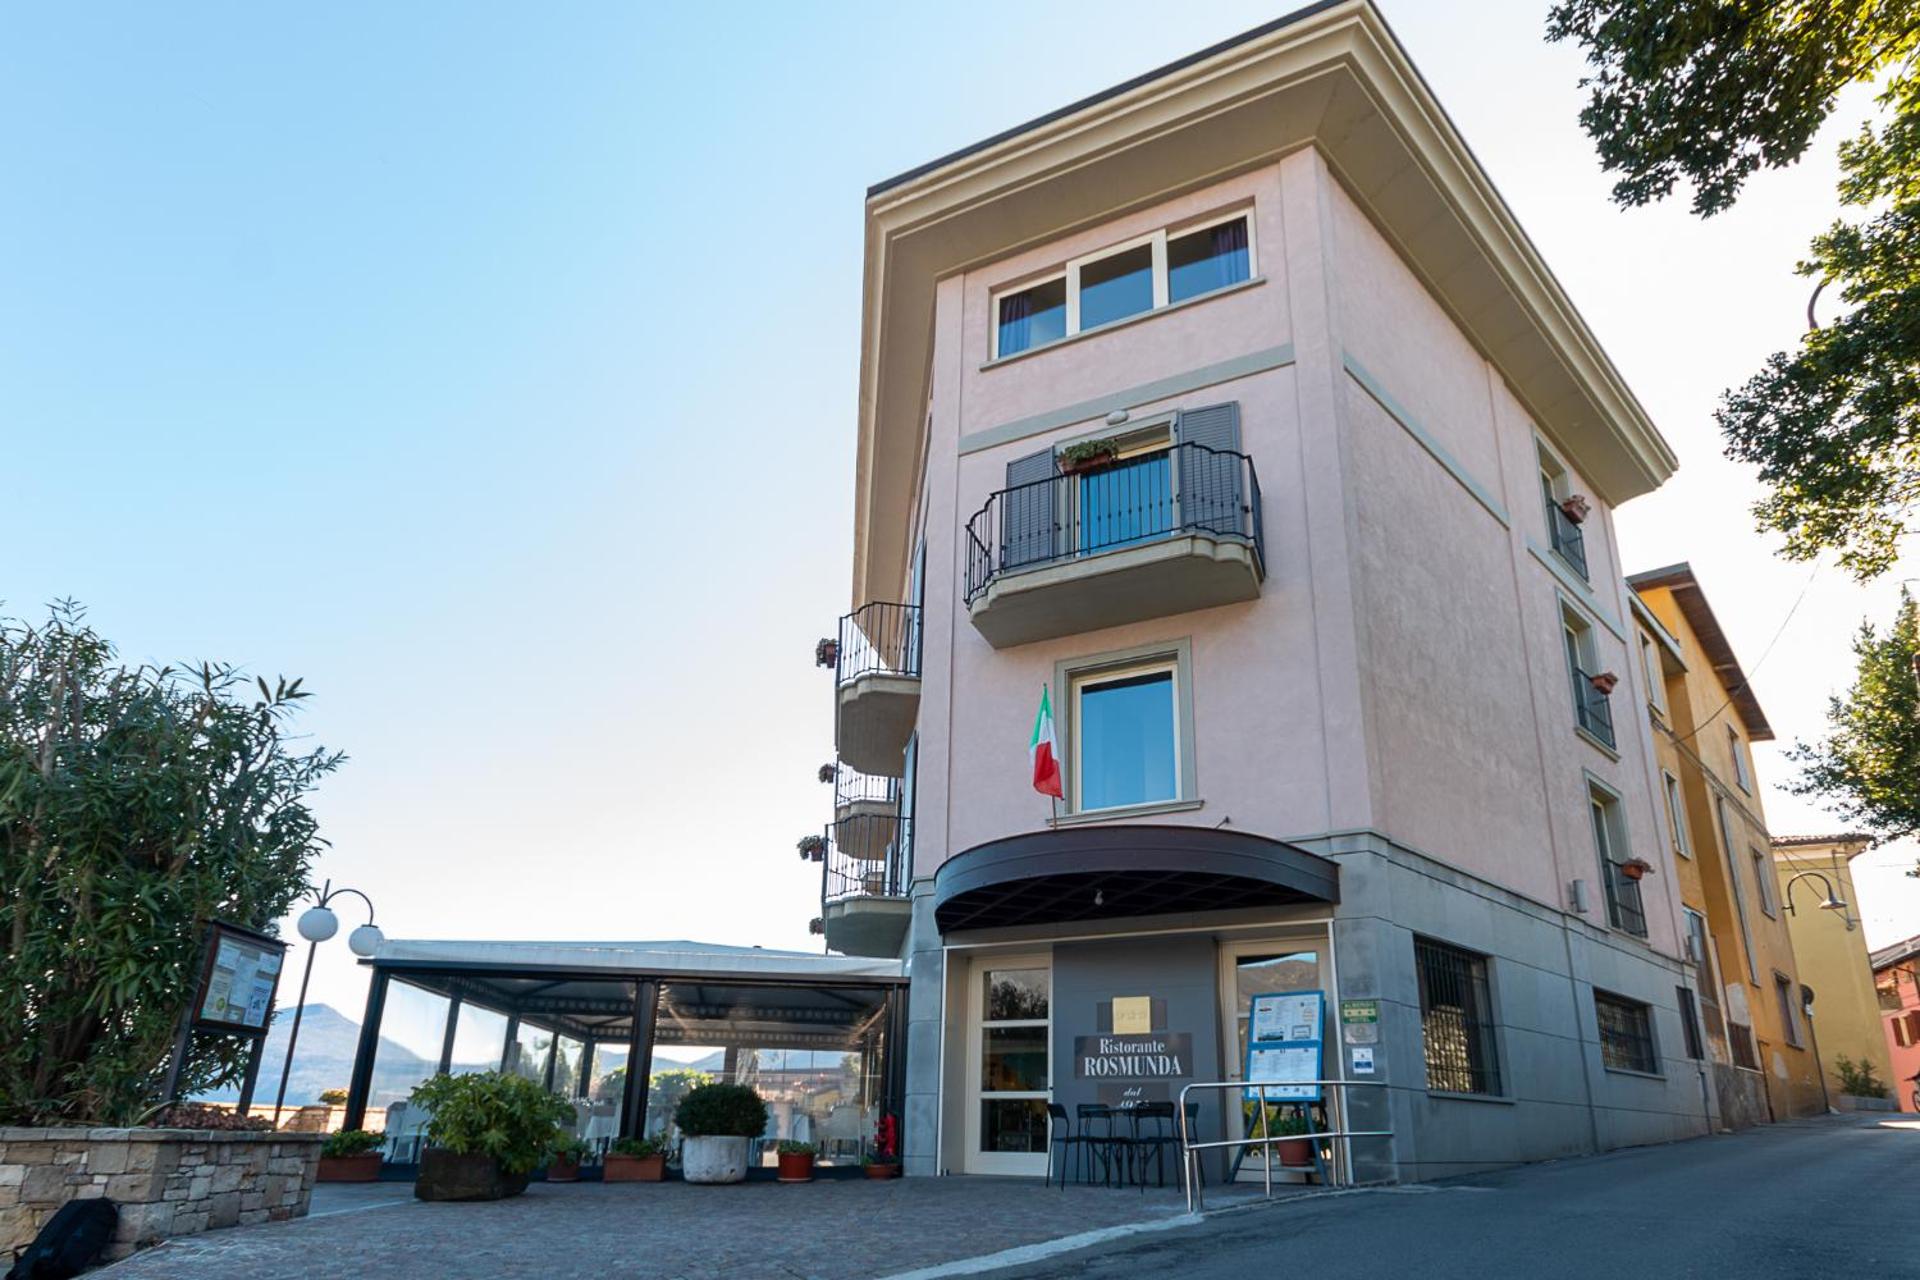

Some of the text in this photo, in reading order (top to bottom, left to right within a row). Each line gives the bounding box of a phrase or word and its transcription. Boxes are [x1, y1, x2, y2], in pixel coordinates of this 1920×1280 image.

[1099, 1038, 1165, 1054] Ristorante
[1084, 1055, 1182, 1076] ROSMUNDA
[1123, 1087, 1142, 1097] dal
